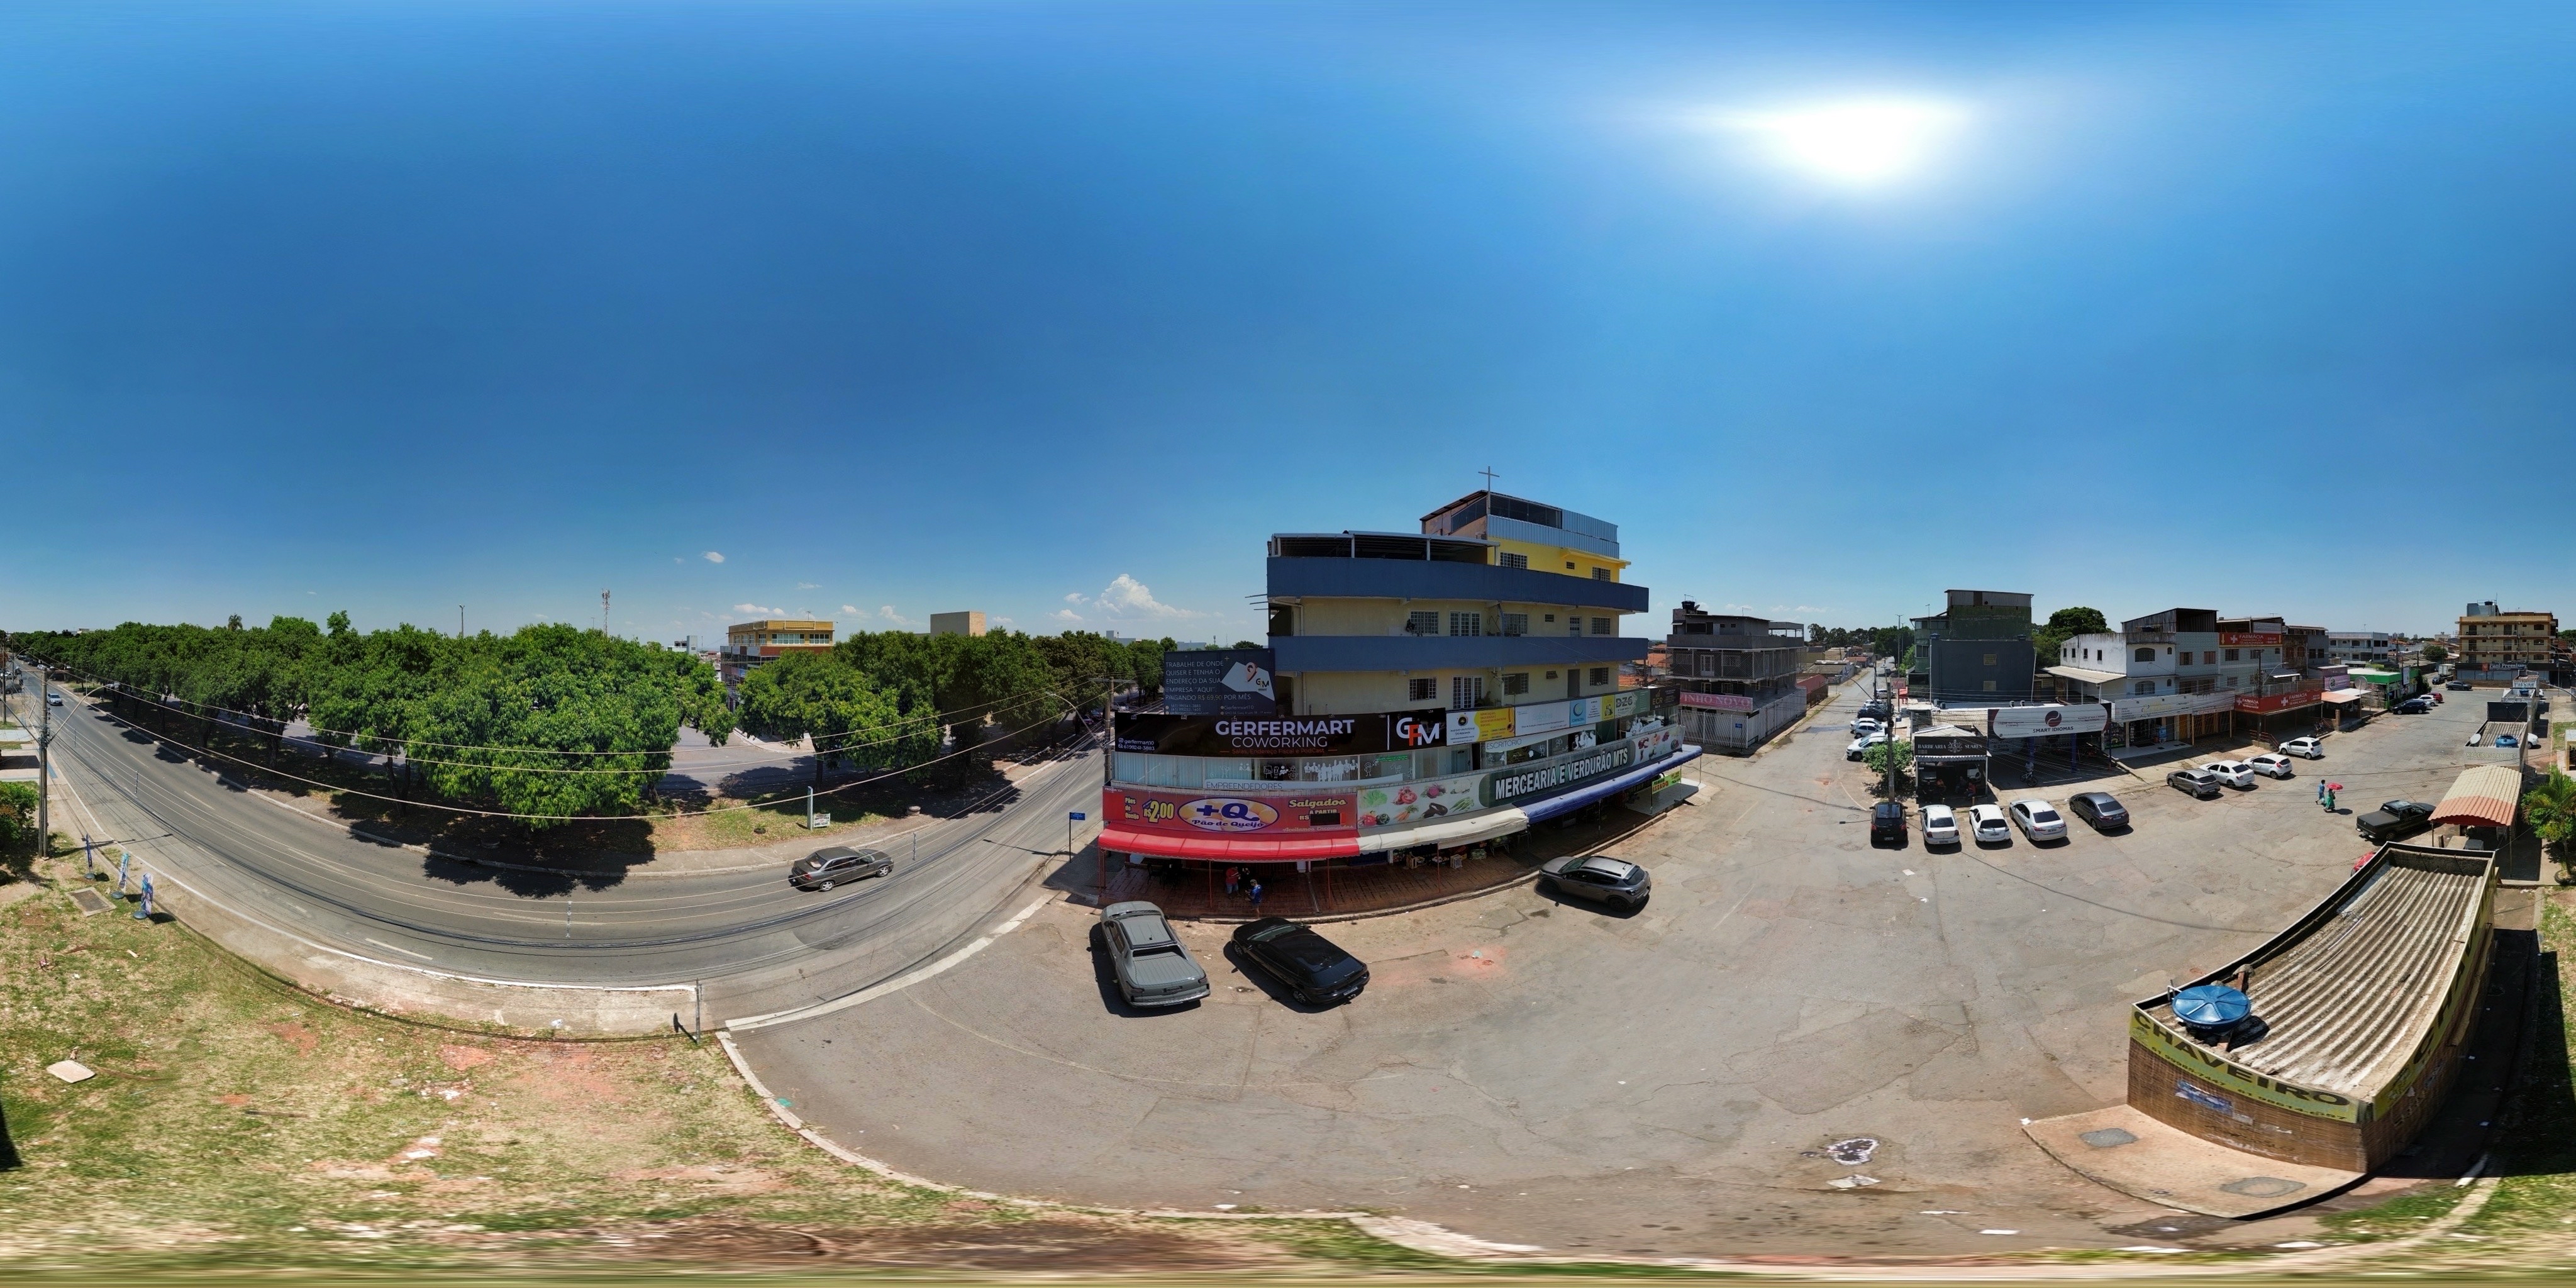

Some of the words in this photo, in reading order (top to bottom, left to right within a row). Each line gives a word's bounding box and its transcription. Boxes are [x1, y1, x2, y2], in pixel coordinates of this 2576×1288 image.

[1715, 696, 1750, 707] NOVO
[1215, 719, 1355, 736] GERFERMART
[1396, 717, 1440, 747] GFM
[1232, 736, 1328, 748] COWORKING
[1495, 766, 1558, 800] MERCEARIA
[1558, 763, 1565, 783] E
[1567, 750, 1613, 781] VERDURÃO
[1613, 747, 1628, 768] MTS
[1206, 782, 1283, 790] EMPREENDEDORES
[1289, 797, 1347, 808] Salgados
[1124, 812, 1140, 821] Queijo
[2134, 1011, 2350, 1106] CHAVEIRO
